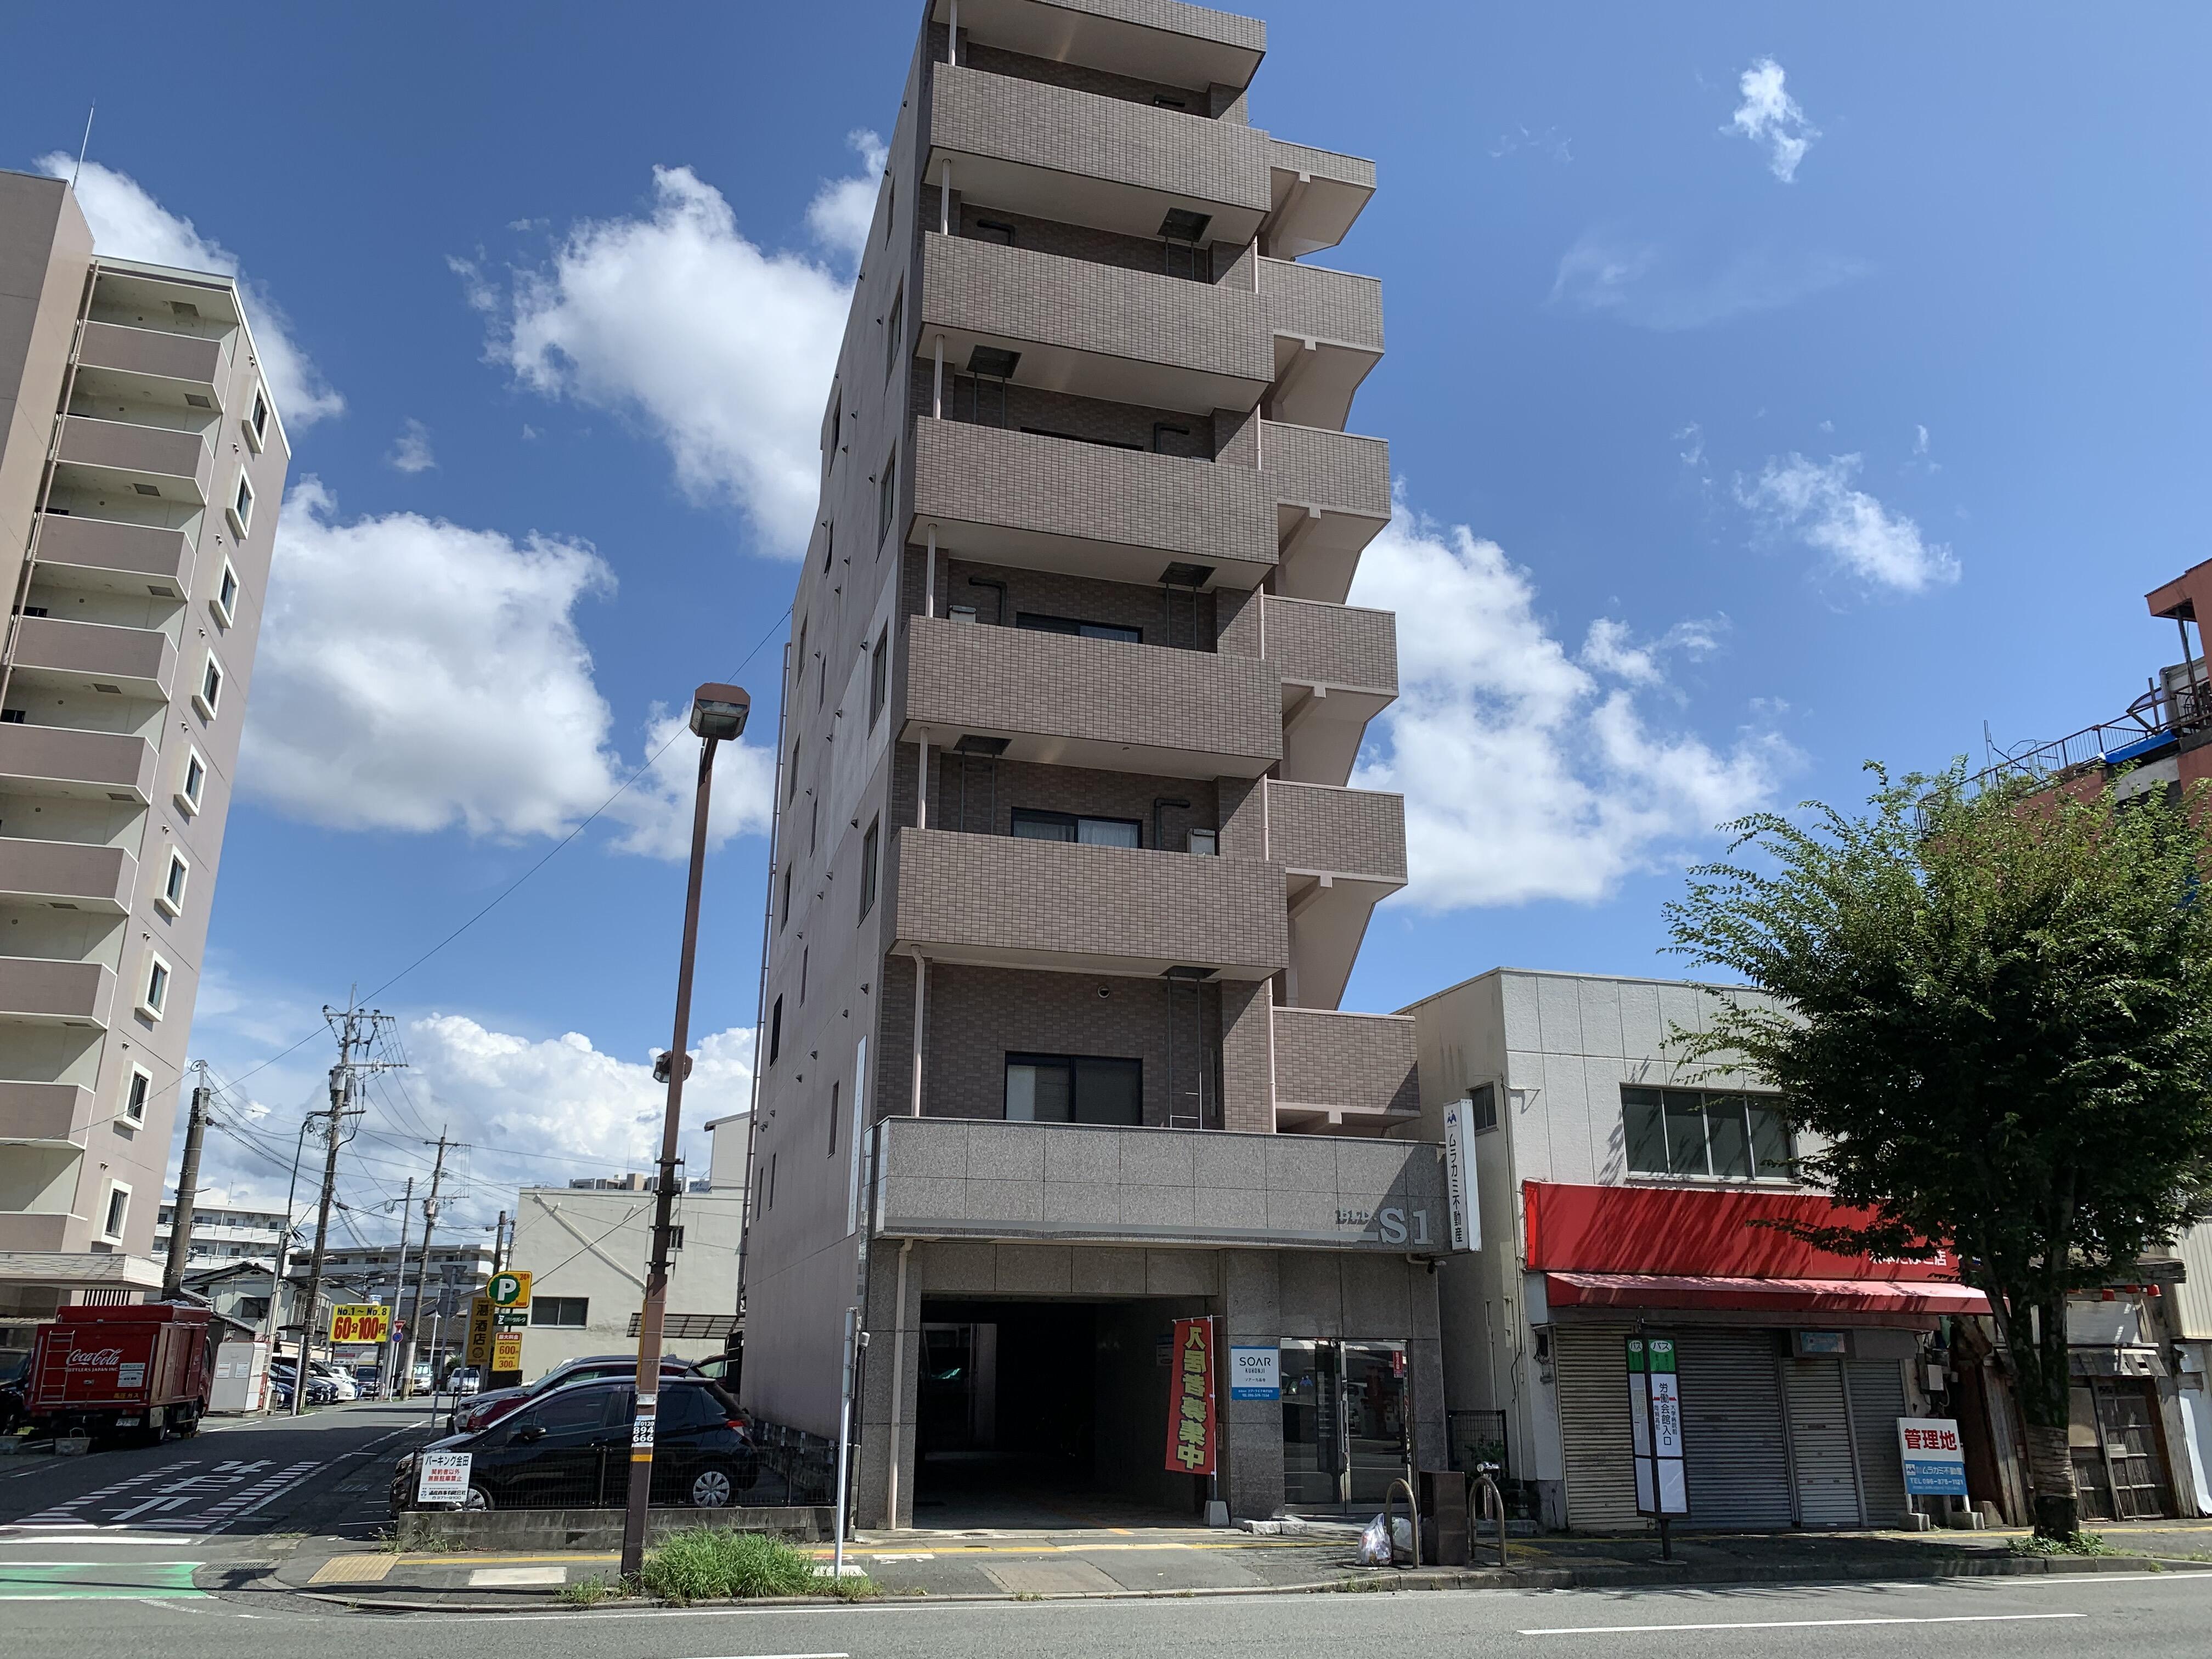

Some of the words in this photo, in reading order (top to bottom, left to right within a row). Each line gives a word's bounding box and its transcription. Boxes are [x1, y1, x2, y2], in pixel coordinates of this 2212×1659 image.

[1449, 1133, 1463, 1243] ムラカミ不動産
[1379, 1207, 1434, 1244] S1
[1630, 1342, 1642, 1350] バス
[1652, 1342, 1670, 1351] バス
[66, 1348, 125, 1366] Coca-Cola
[1239, 1357, 1271, 1367] SOAR
[1659, 1383, 1672, 1446] 労働会館入口
[633, 1426, 654, 1435] 894
[633, 1434, 654, 1442] 666
[1904, 1428, 1957, 1451] 管理地
[425, 1455, 470, 1466] パーキング金田
